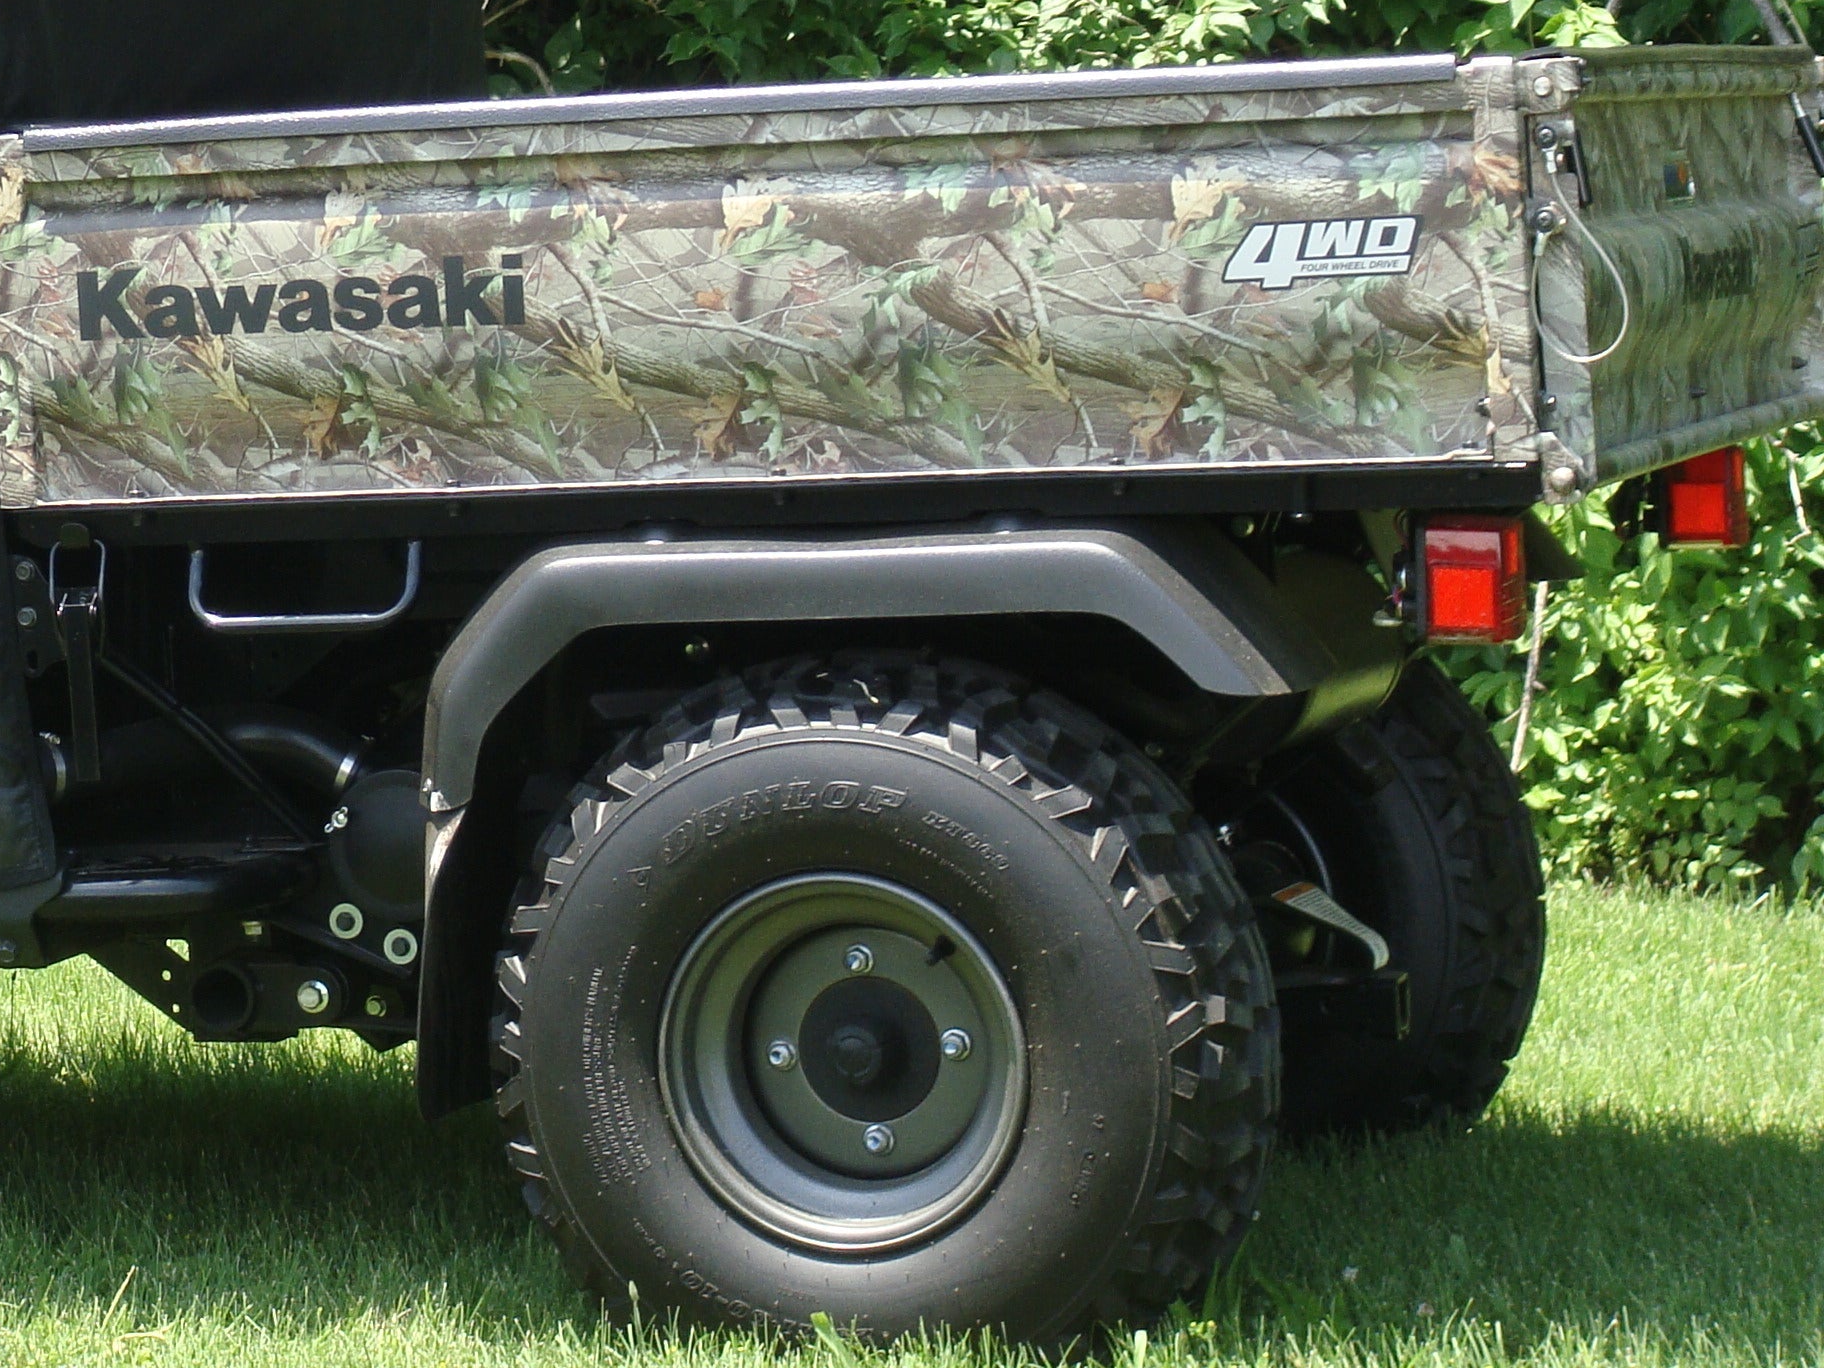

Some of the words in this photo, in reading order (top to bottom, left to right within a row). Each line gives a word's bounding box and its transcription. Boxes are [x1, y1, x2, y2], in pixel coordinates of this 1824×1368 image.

[1224, 217, 1417, 288] 4WD
[1300, 262, 1329, 272] FOUR
[1331, 261, 1366, 271] WHEEL
[1368, 259, 1400, 270] DRIVE
[77, 254, 525, 341] Kawasaki
[660, 780, 908, 864] DUNLOP
